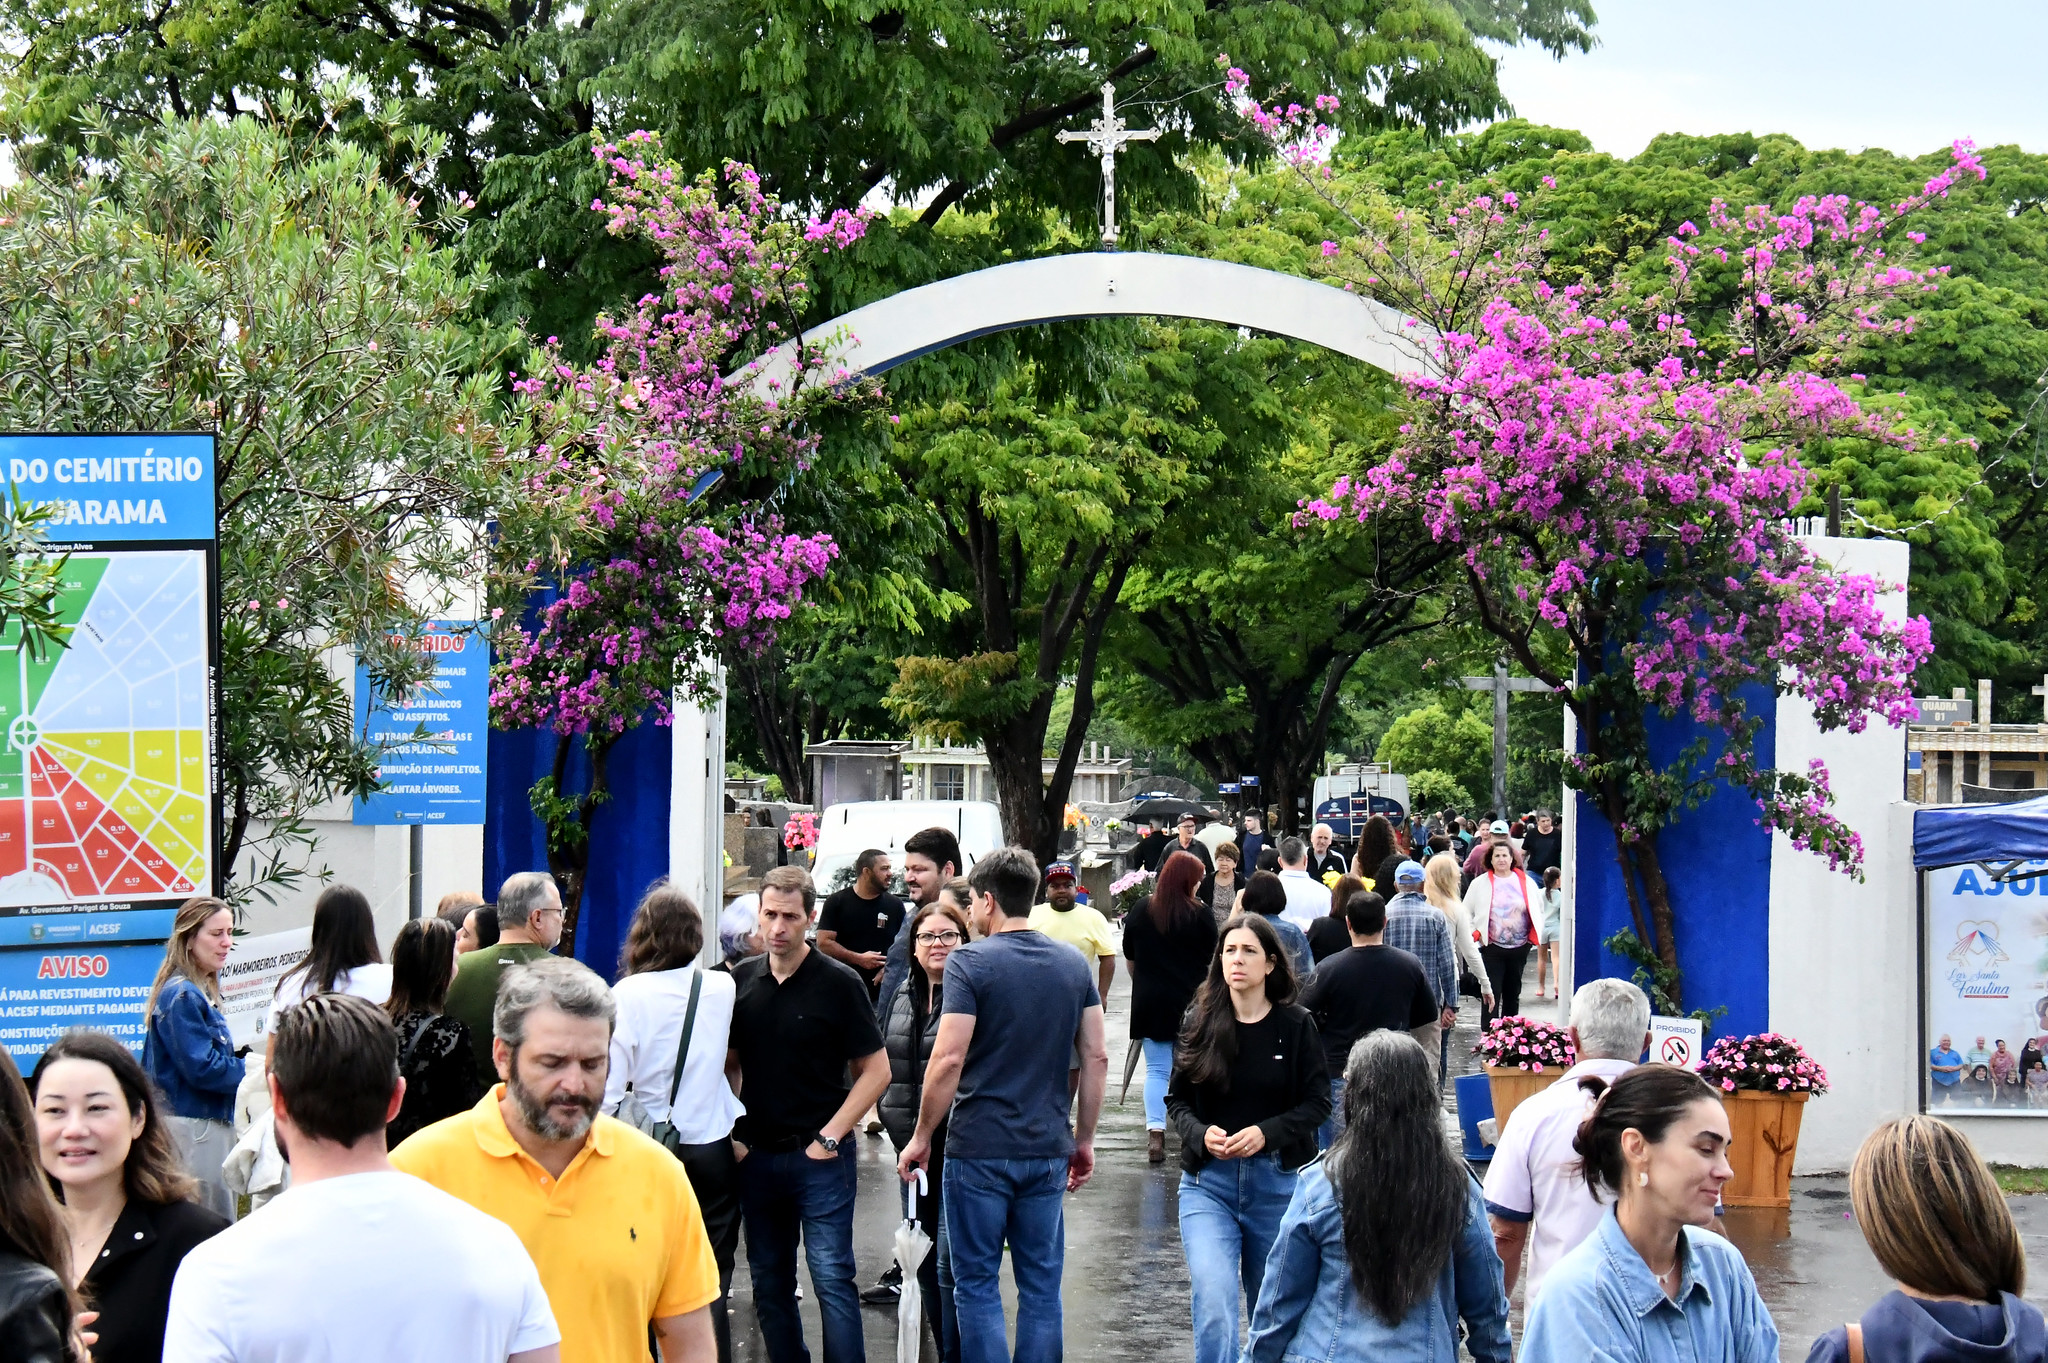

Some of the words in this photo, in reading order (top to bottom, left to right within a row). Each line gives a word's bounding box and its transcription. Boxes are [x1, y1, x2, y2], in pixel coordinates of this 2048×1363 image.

[10, 458, 48, 484] DO
[54, 448, 203, 484] CEMITÉRIO
[428, 700, 462, 709] BANCOS
[1922, 701, 1958, 711] QUADRA
[392, 712, 404, 721] OU
[406, 712, 451, 722] ASSENTOS.
[423, 765, 432, 774] DE
[434, 765, 482, 774] PANFLETOS.
[421, 782, 462, 793] ÁRVORES.
[19, 907, 30, 915] Av.
[32, 905, 72, 914] Governador
[73, 904, 98, 914] Parigot
[89, 923, 121, 935] ACESF
[38, 955, 109, 979] AVISO
[9, 989, 38, 1001] PARA
[40, 987, 121, 1000] REVESTIMENTO
[1952, 979, 2010, 998] Faustina
[6, 1005, 39, 1017] ACESF
[41, 1004, 95, 1015] MEDIANTE
[97, 1002, 148, 1014] PAGAMEN
[1656, 1025, 1696, 1034] PROIBIDO
